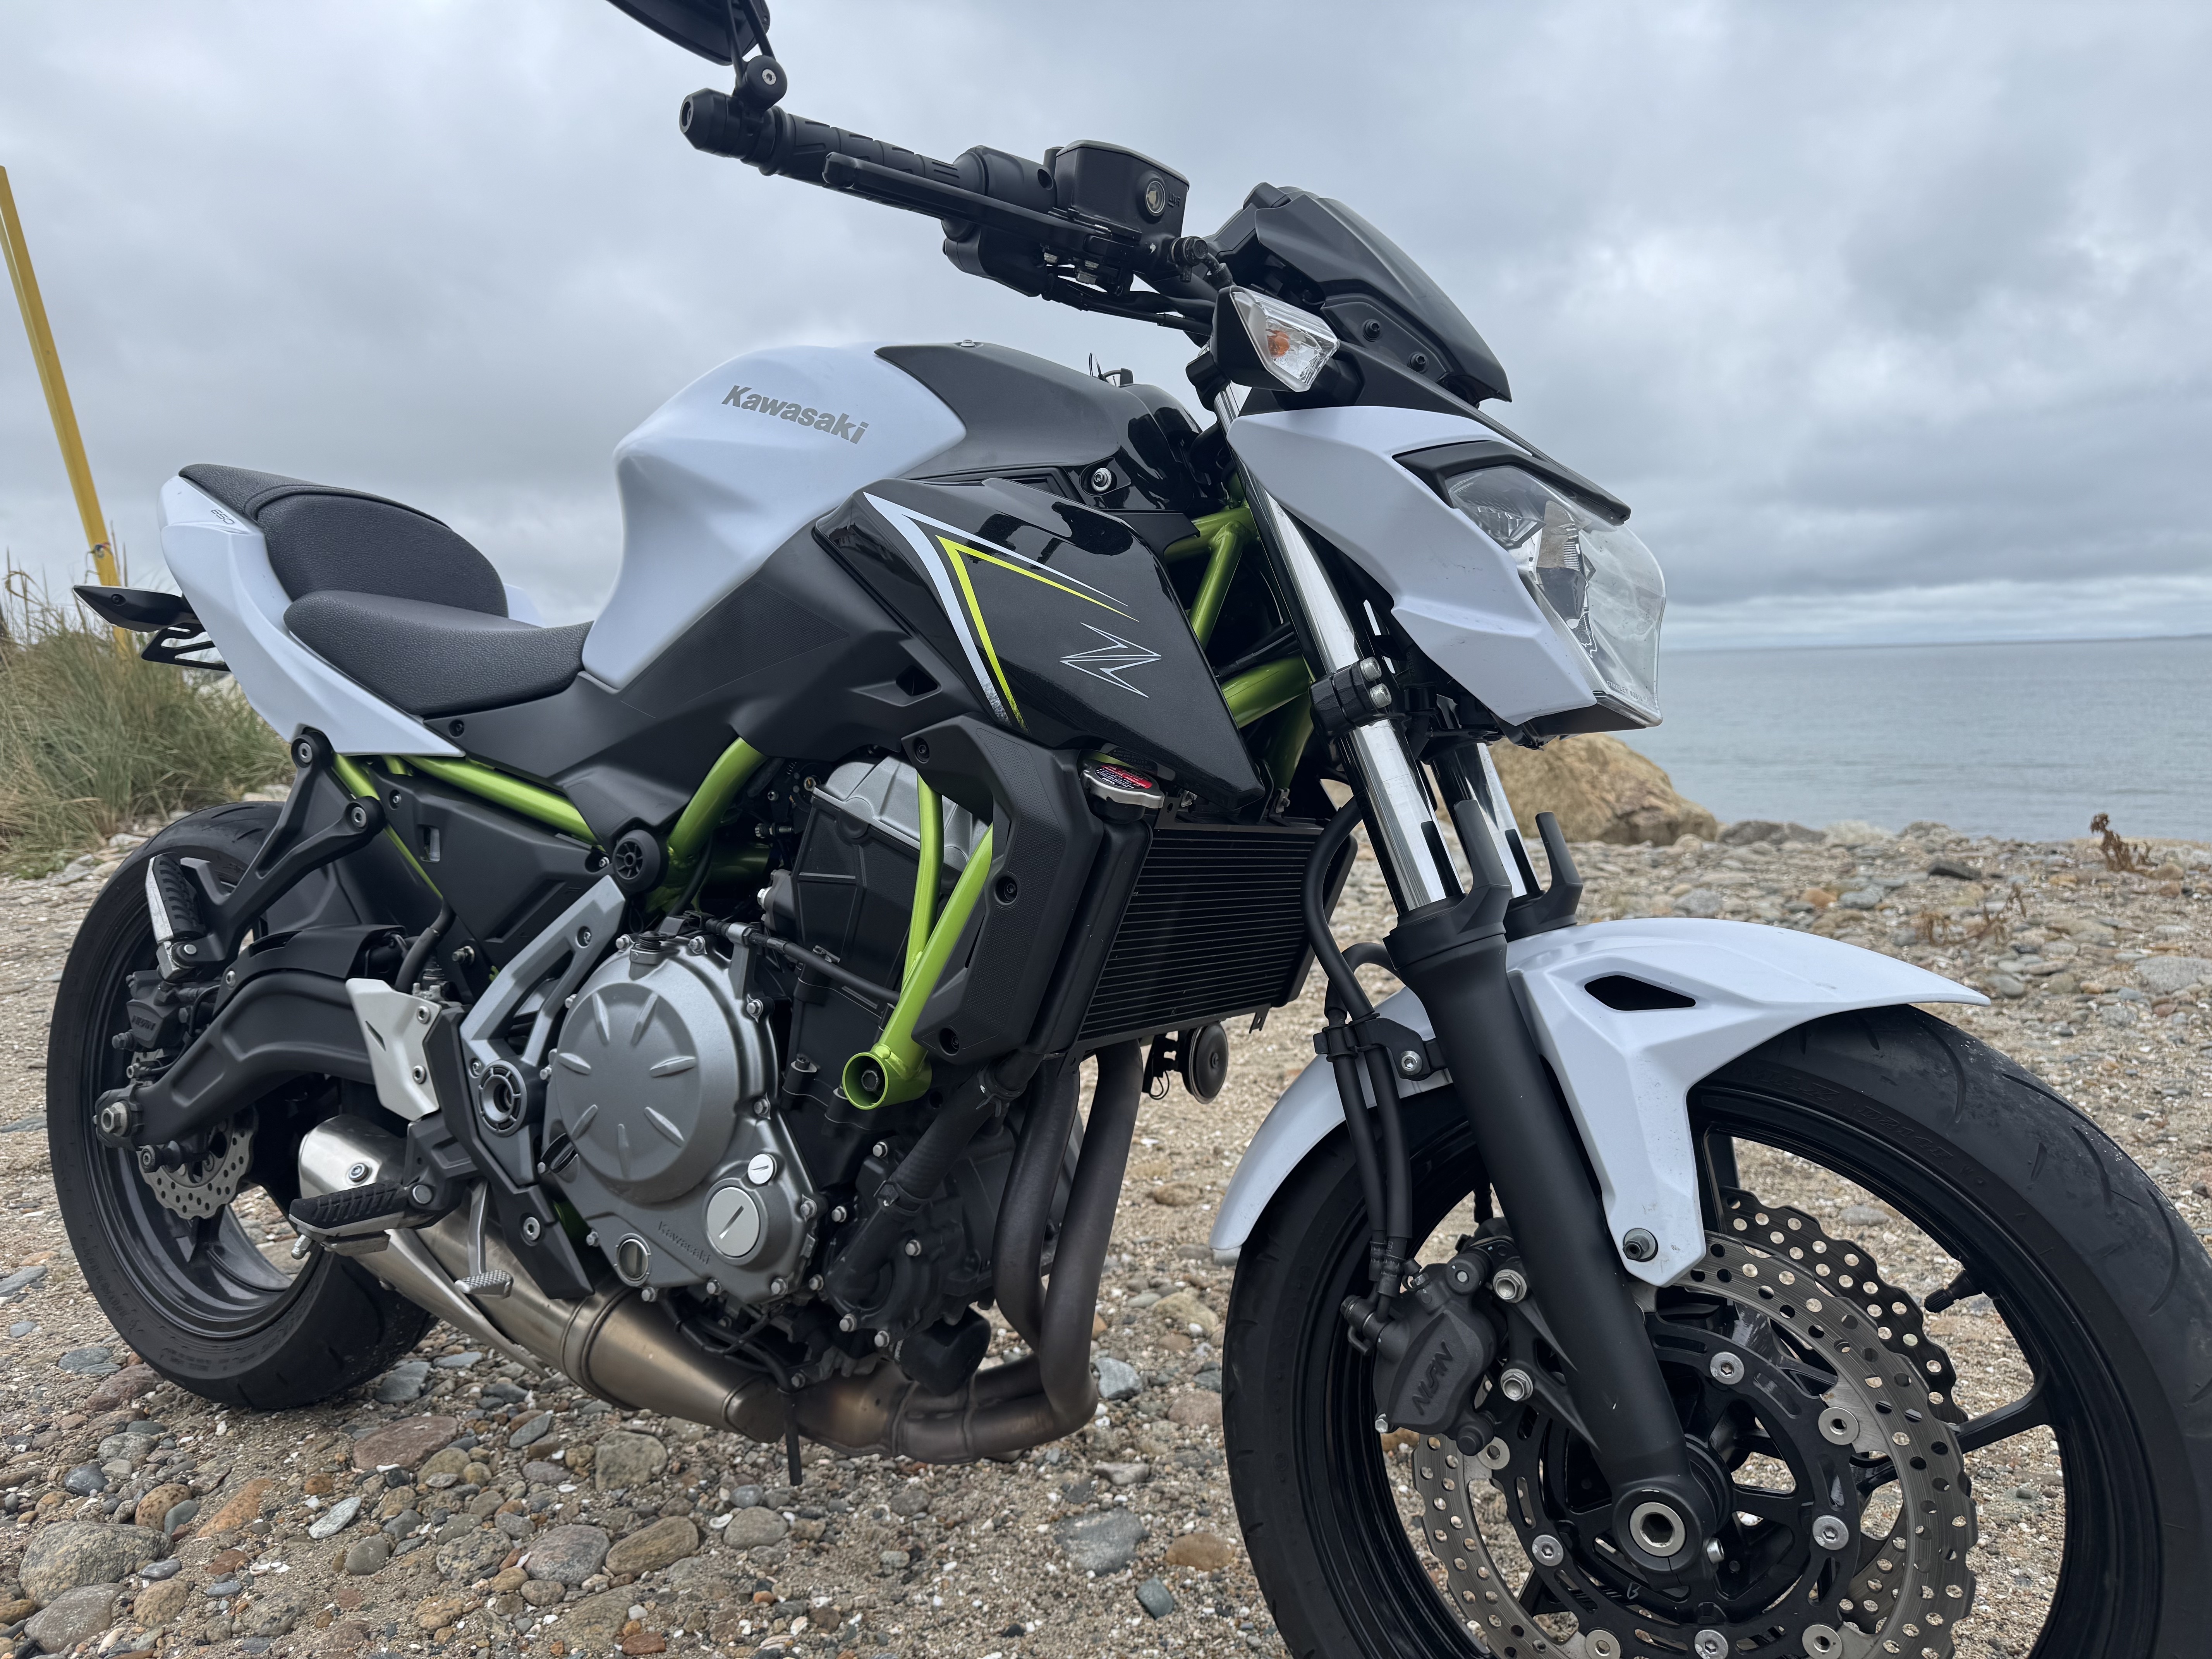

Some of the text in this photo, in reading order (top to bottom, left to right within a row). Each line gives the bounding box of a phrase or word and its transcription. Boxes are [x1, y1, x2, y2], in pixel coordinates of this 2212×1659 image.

[721, 385, 869, 444] Kawasaki
[211, 508, 235, 525] 650
[1858, 1106, 1953, 1161] D214F
[658, 1221, 711, 1266] Kawasaki
